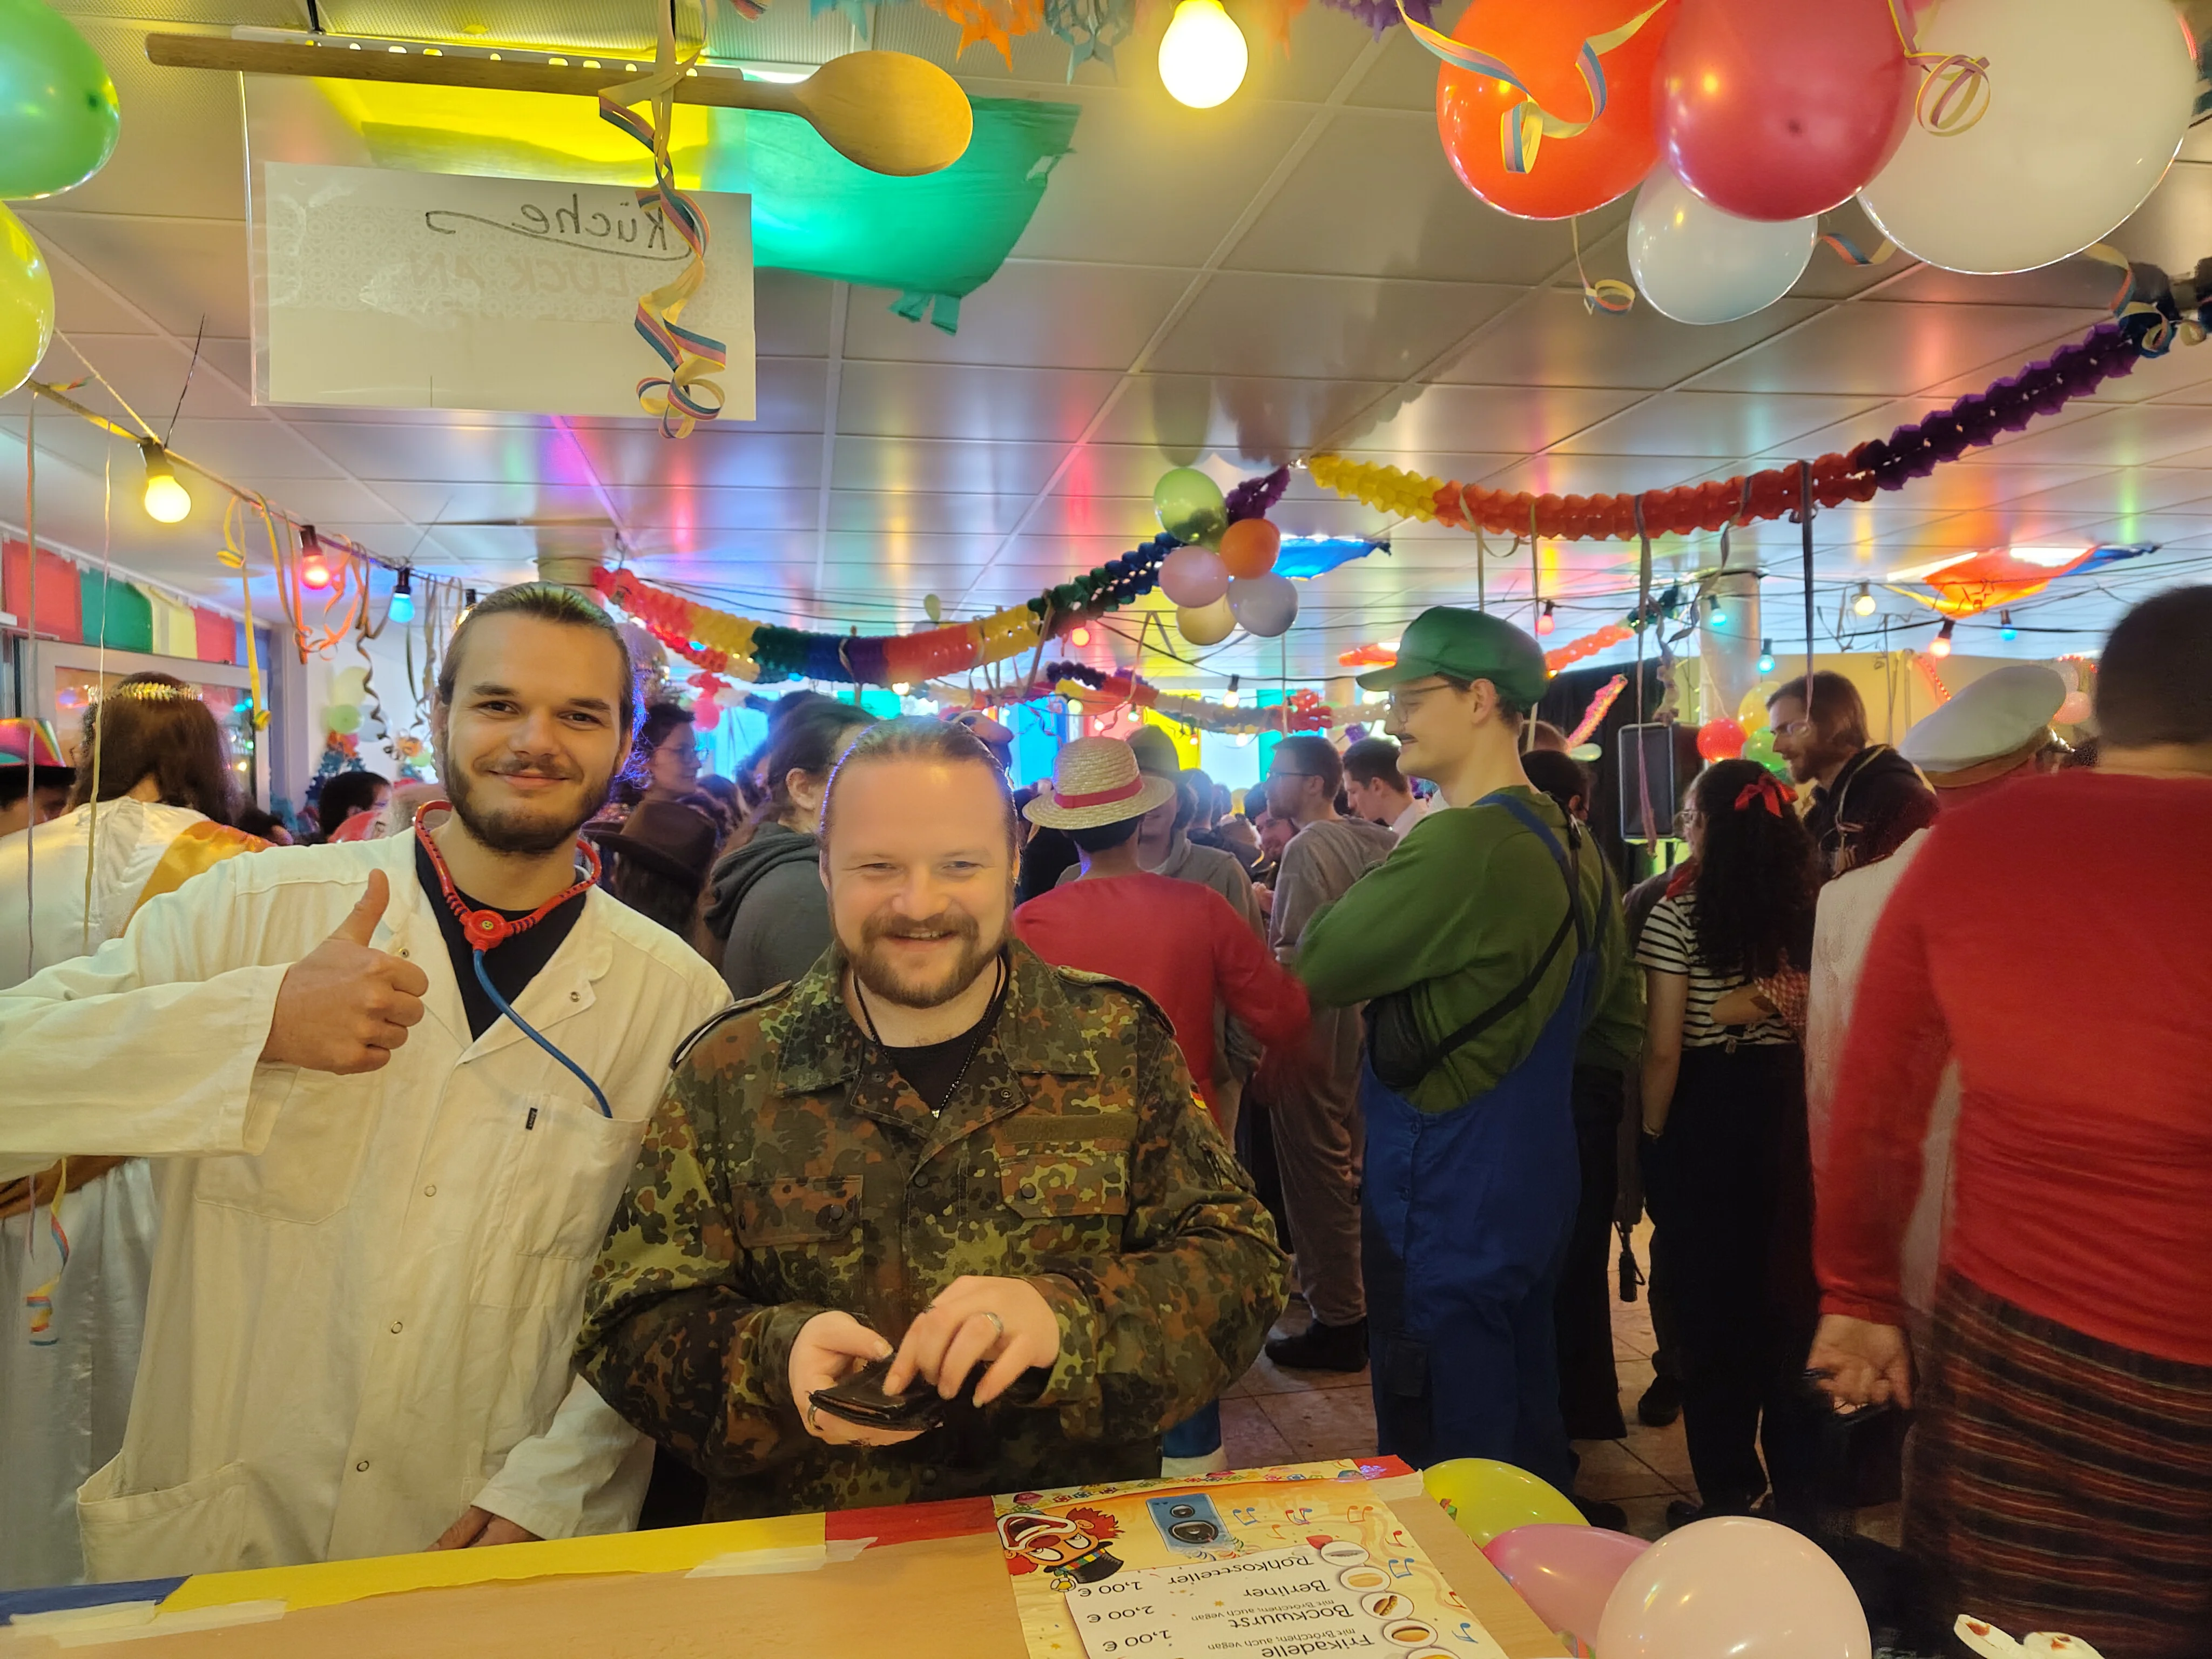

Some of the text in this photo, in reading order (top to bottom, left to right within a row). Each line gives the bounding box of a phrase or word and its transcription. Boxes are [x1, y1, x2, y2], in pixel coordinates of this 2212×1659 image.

[1078, 1555, 1314, 1597] Rohkostteller 1,00 €
[1087, 1580, 1331, 1623] Berliner 2,00 €
[1190, 1611, 1225, 1621] vegan
[1226, 1606, 1255, 1616] auch
[1102, 1604, 1354, 1652] Bockwurst 1,00 €
[1207, 1642, 1243, 1651] vegan
[1244, 1637, 1273, 1647] auch
[1262, 1634, 1375, 1658] Frikadelle
